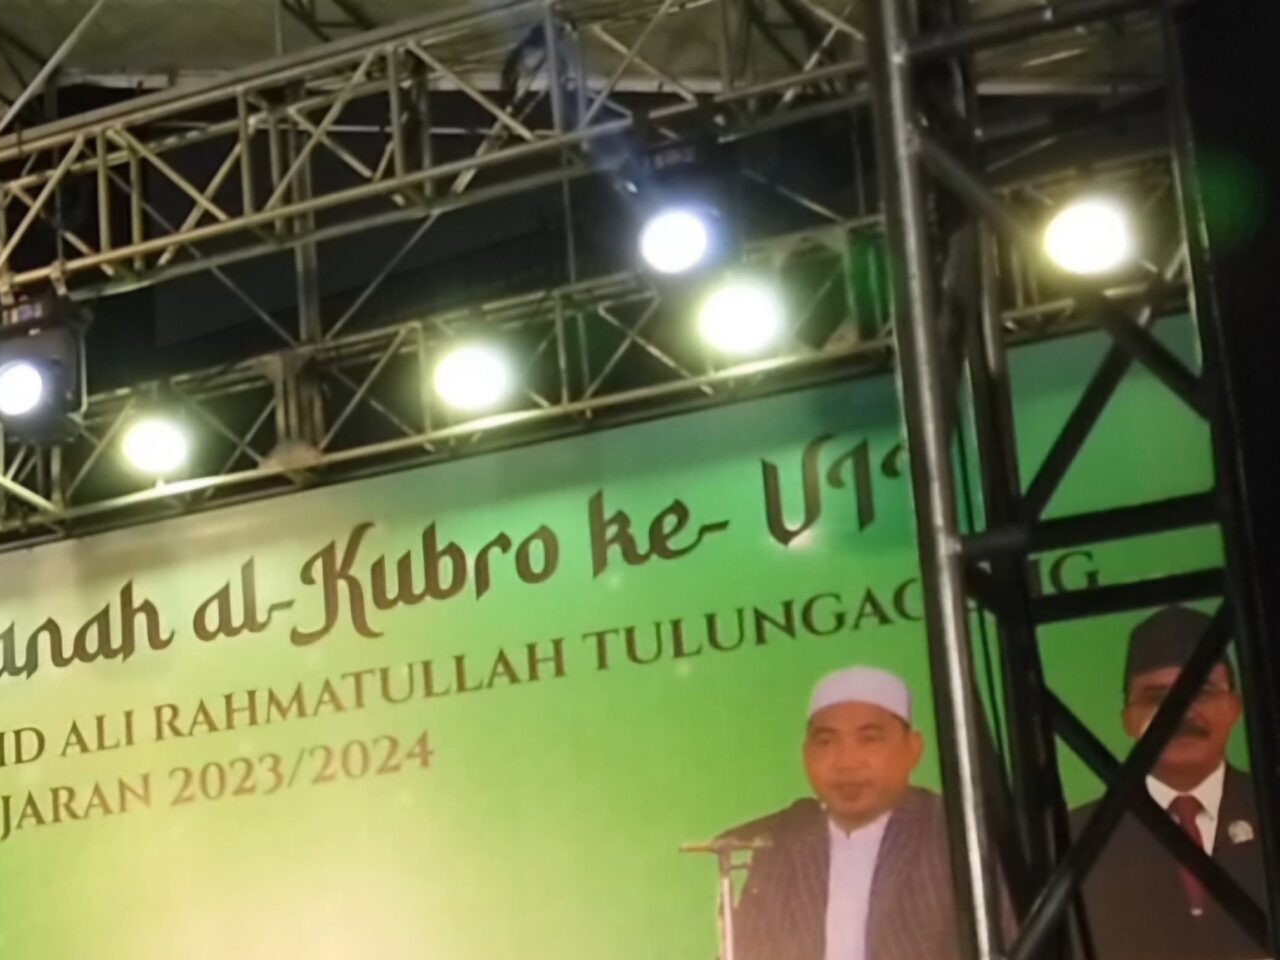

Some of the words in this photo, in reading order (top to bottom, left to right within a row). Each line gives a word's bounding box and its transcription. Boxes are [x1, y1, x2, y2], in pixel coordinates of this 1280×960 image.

[60, 709, 135, 758] ALI
[153, 637, 564, 741] RAHMATULLAH
[169, 730, 433, 806] 2023/2024
